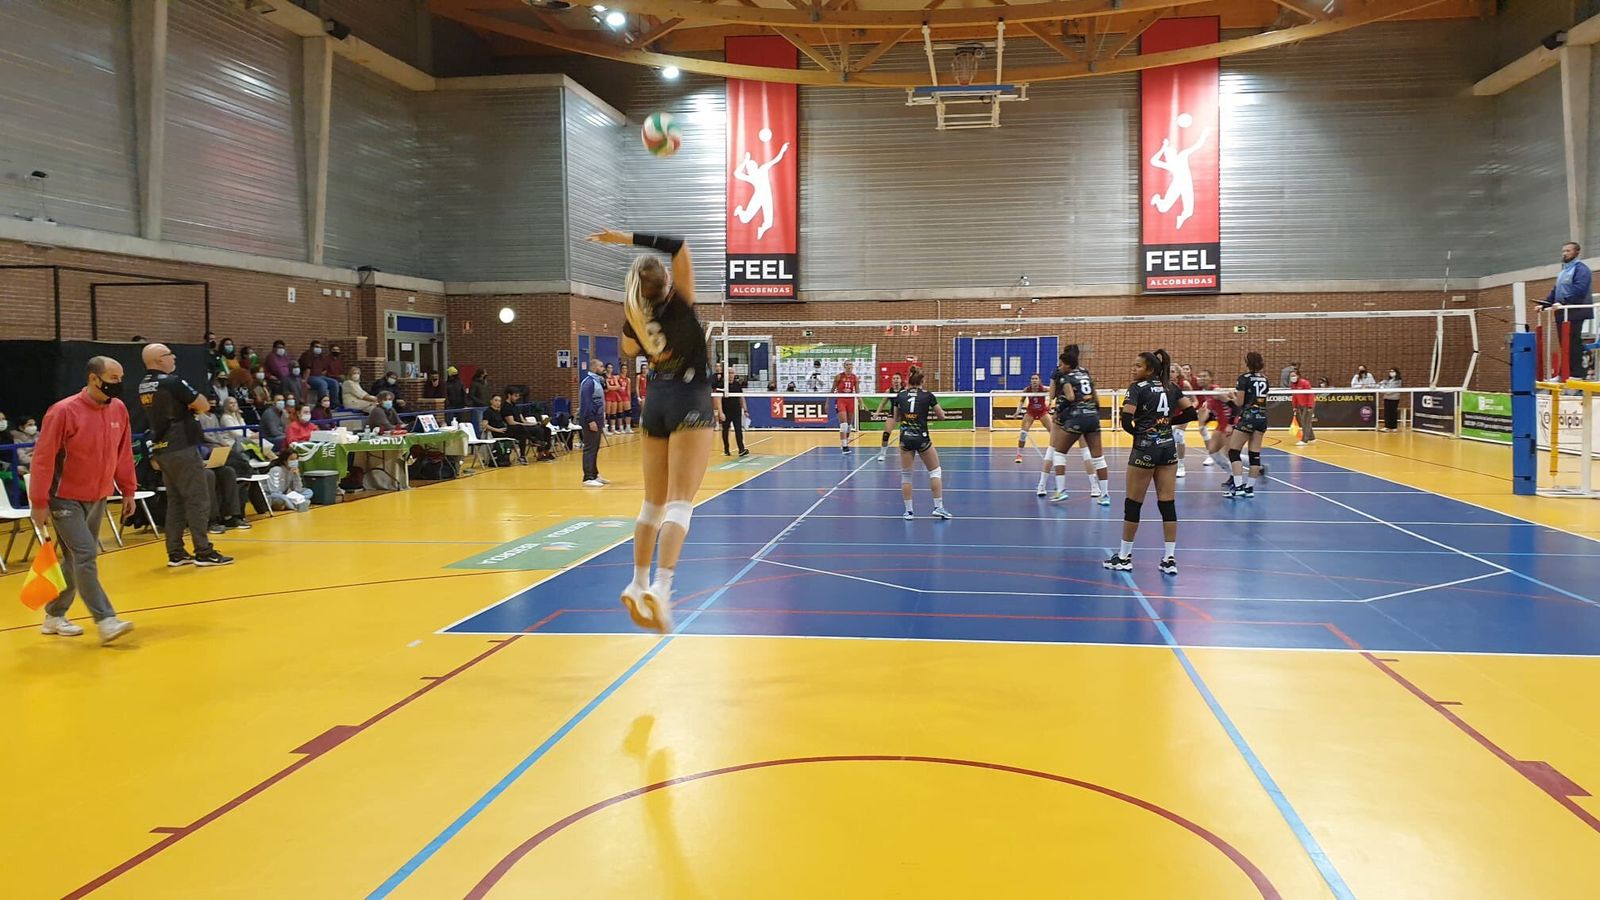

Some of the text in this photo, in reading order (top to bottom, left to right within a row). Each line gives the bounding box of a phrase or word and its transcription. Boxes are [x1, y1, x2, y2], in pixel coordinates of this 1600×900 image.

[1146, 250, 1216, 271] FEEL
[729, 260, 793, 279] FEEL
[1150, 278, 1213, 286] ALCOBENDAS
[1080, 380, 1092, 394] 8
[1253, 381, 1267, 397] 12
[783, 404, 828, 418] FEEL
[907, 396, 916, 413] 1
[1156, 392, 1170, 416] 4
